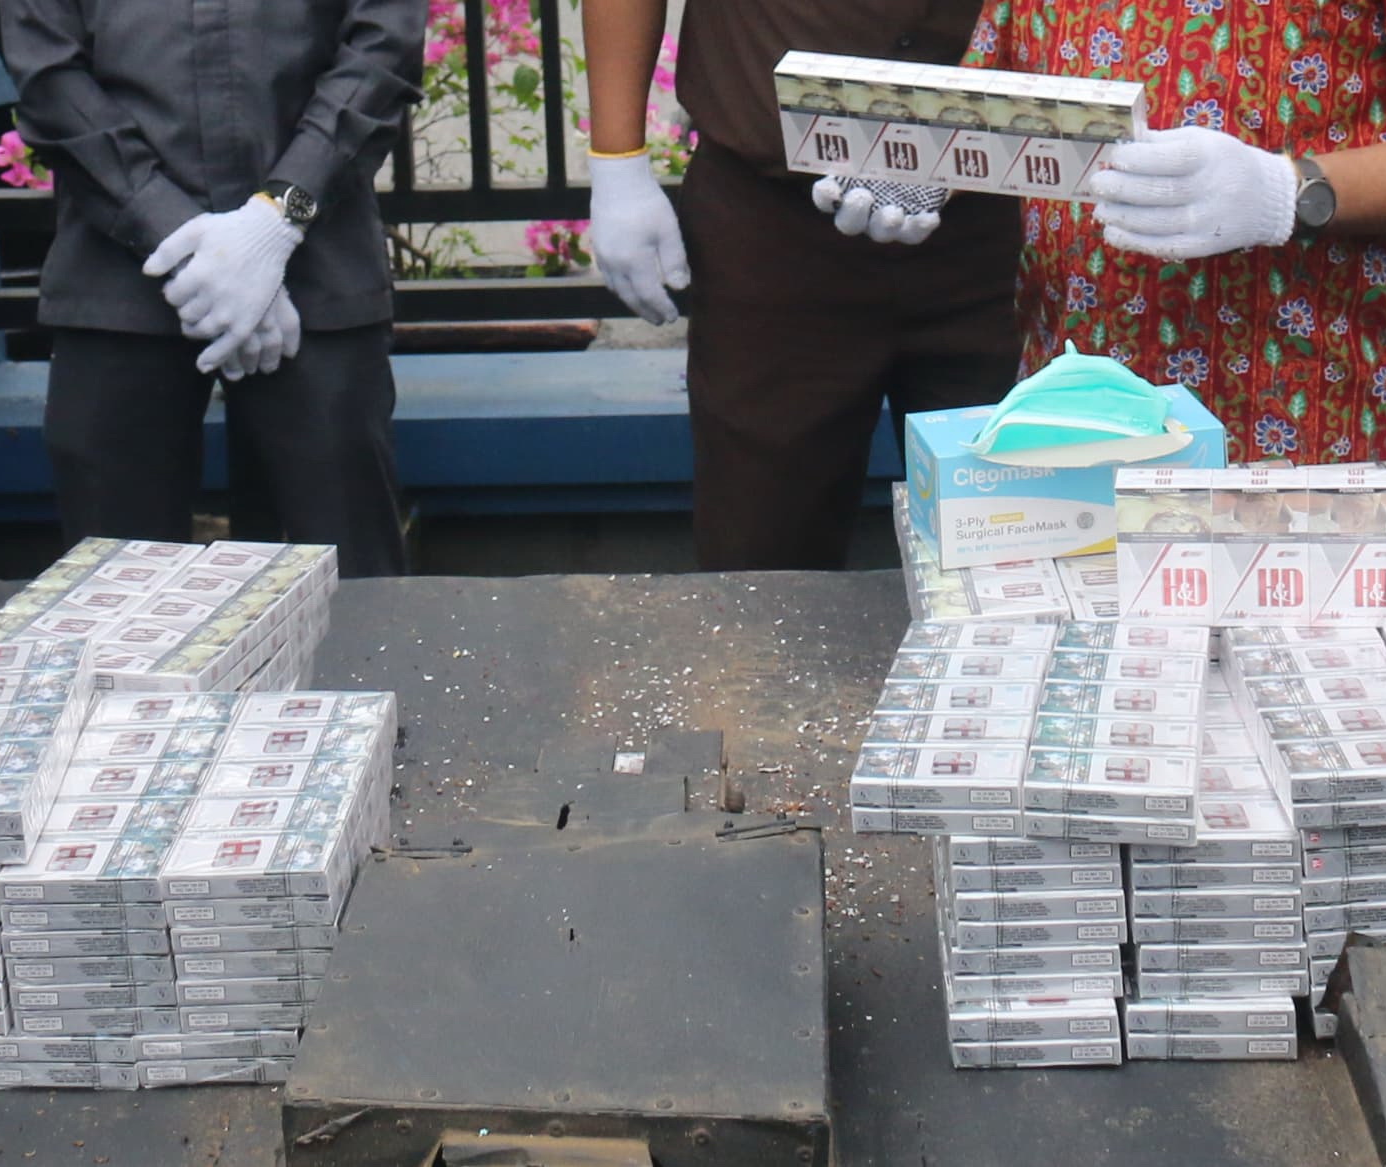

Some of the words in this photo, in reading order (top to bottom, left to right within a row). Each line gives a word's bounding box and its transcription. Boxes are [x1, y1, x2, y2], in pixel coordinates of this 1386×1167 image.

[955, 517, 986, 529] 3-Ply
[956, 529, 1004, 541] Surgical
[1007, 520, 1067, 535] FaceMask
[1163, 568, 1208, 606] H&D
[1257, 568, 1304, 607] H&D
